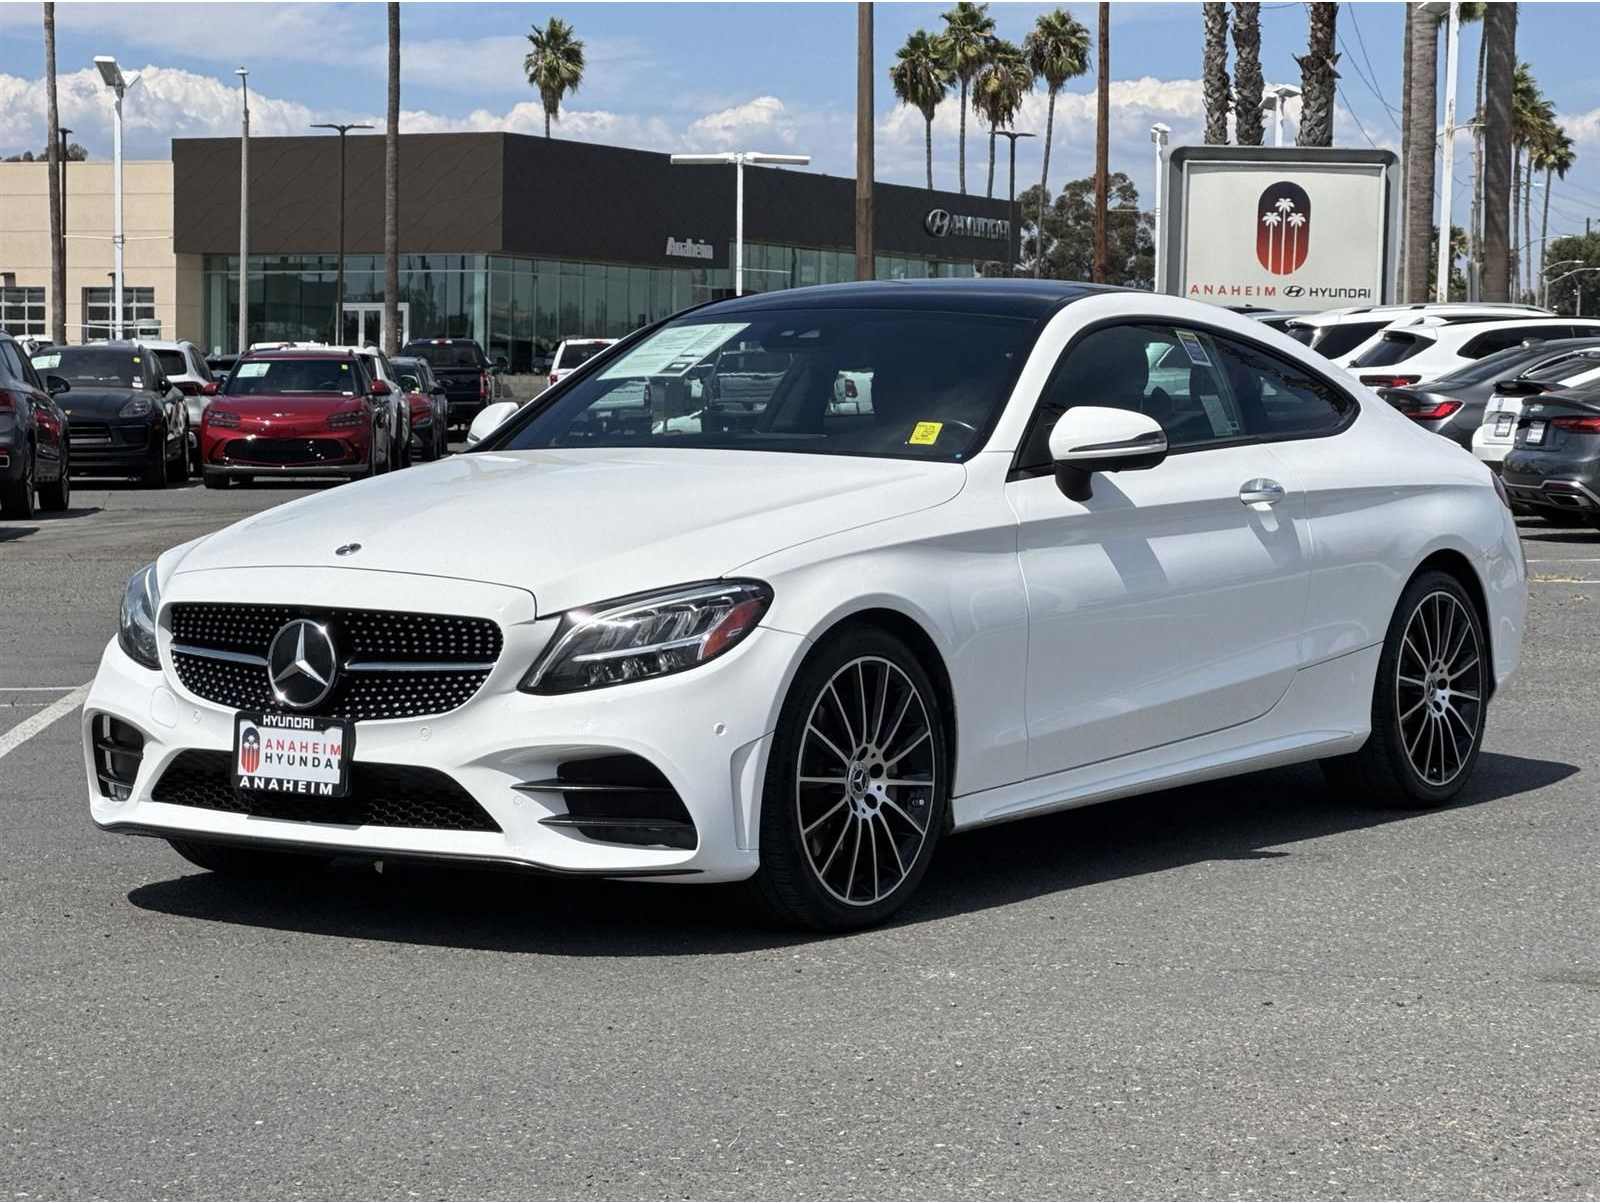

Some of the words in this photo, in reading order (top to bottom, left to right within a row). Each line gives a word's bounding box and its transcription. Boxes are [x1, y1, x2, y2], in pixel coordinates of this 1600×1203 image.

[1190, 284, 1276, 296] ANAHEIM
[1309, 288, 1371, 298] HYUNDAI
[263, 715, 314, 729] HYUNDAI
[265, 739, 341, 755] ANAHEIM
[240, 776, 333, 795] ANAHEIM
